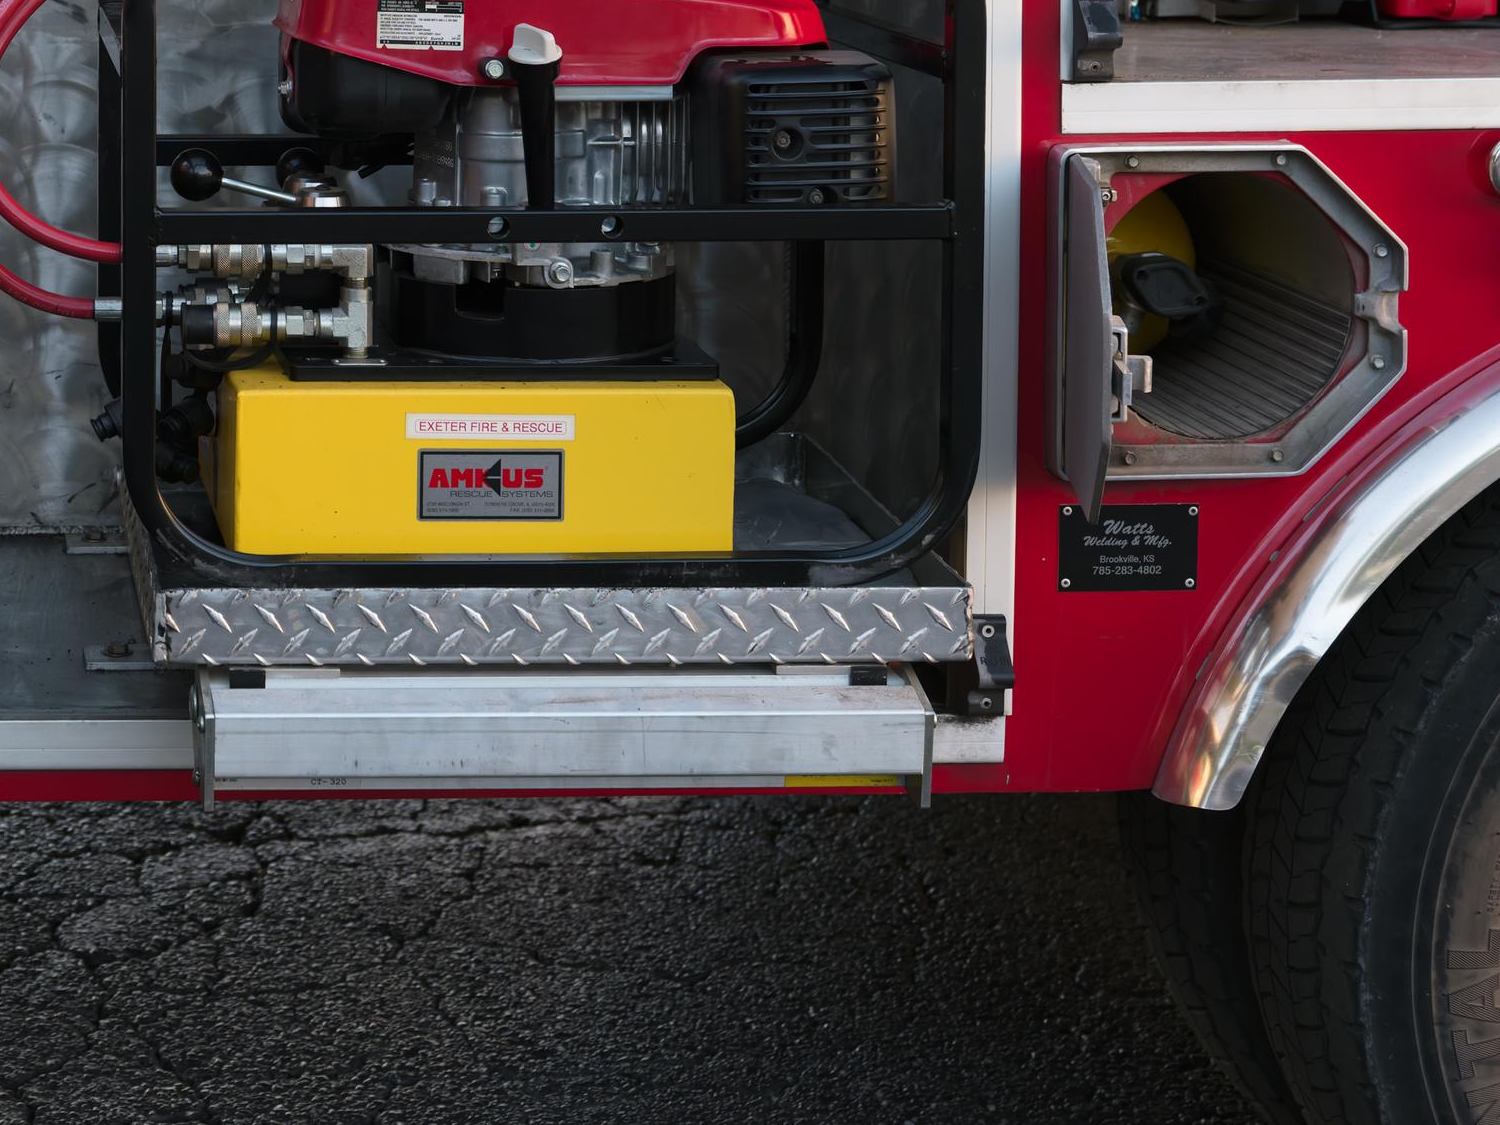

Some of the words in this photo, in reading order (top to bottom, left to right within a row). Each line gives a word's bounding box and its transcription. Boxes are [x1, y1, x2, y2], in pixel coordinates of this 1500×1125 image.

[419, 421, 467, 432] EXETER
[471, 422, 498, 432] FIRE
[501, 422, 509, 432] &
[512, 422, 563, 433] RESCUE
[428, 468, 544, 489] AMKUS
[450, 490, 493, 498] RESCUE
[501, 490, 554, 498] SYSTEMS
[1103, 519, 1155, 535] Watts
[1083, 536, 1129, 549] Welding
[1131, 535, 1140, 546] &
[1143, 535, 1172, 549] Mfg.
[1100, 555, 1141, 564] Brookville,
[1143, 555, 1155, 563] KS
[1092, 565, 1162, 575] 785-283-4802
